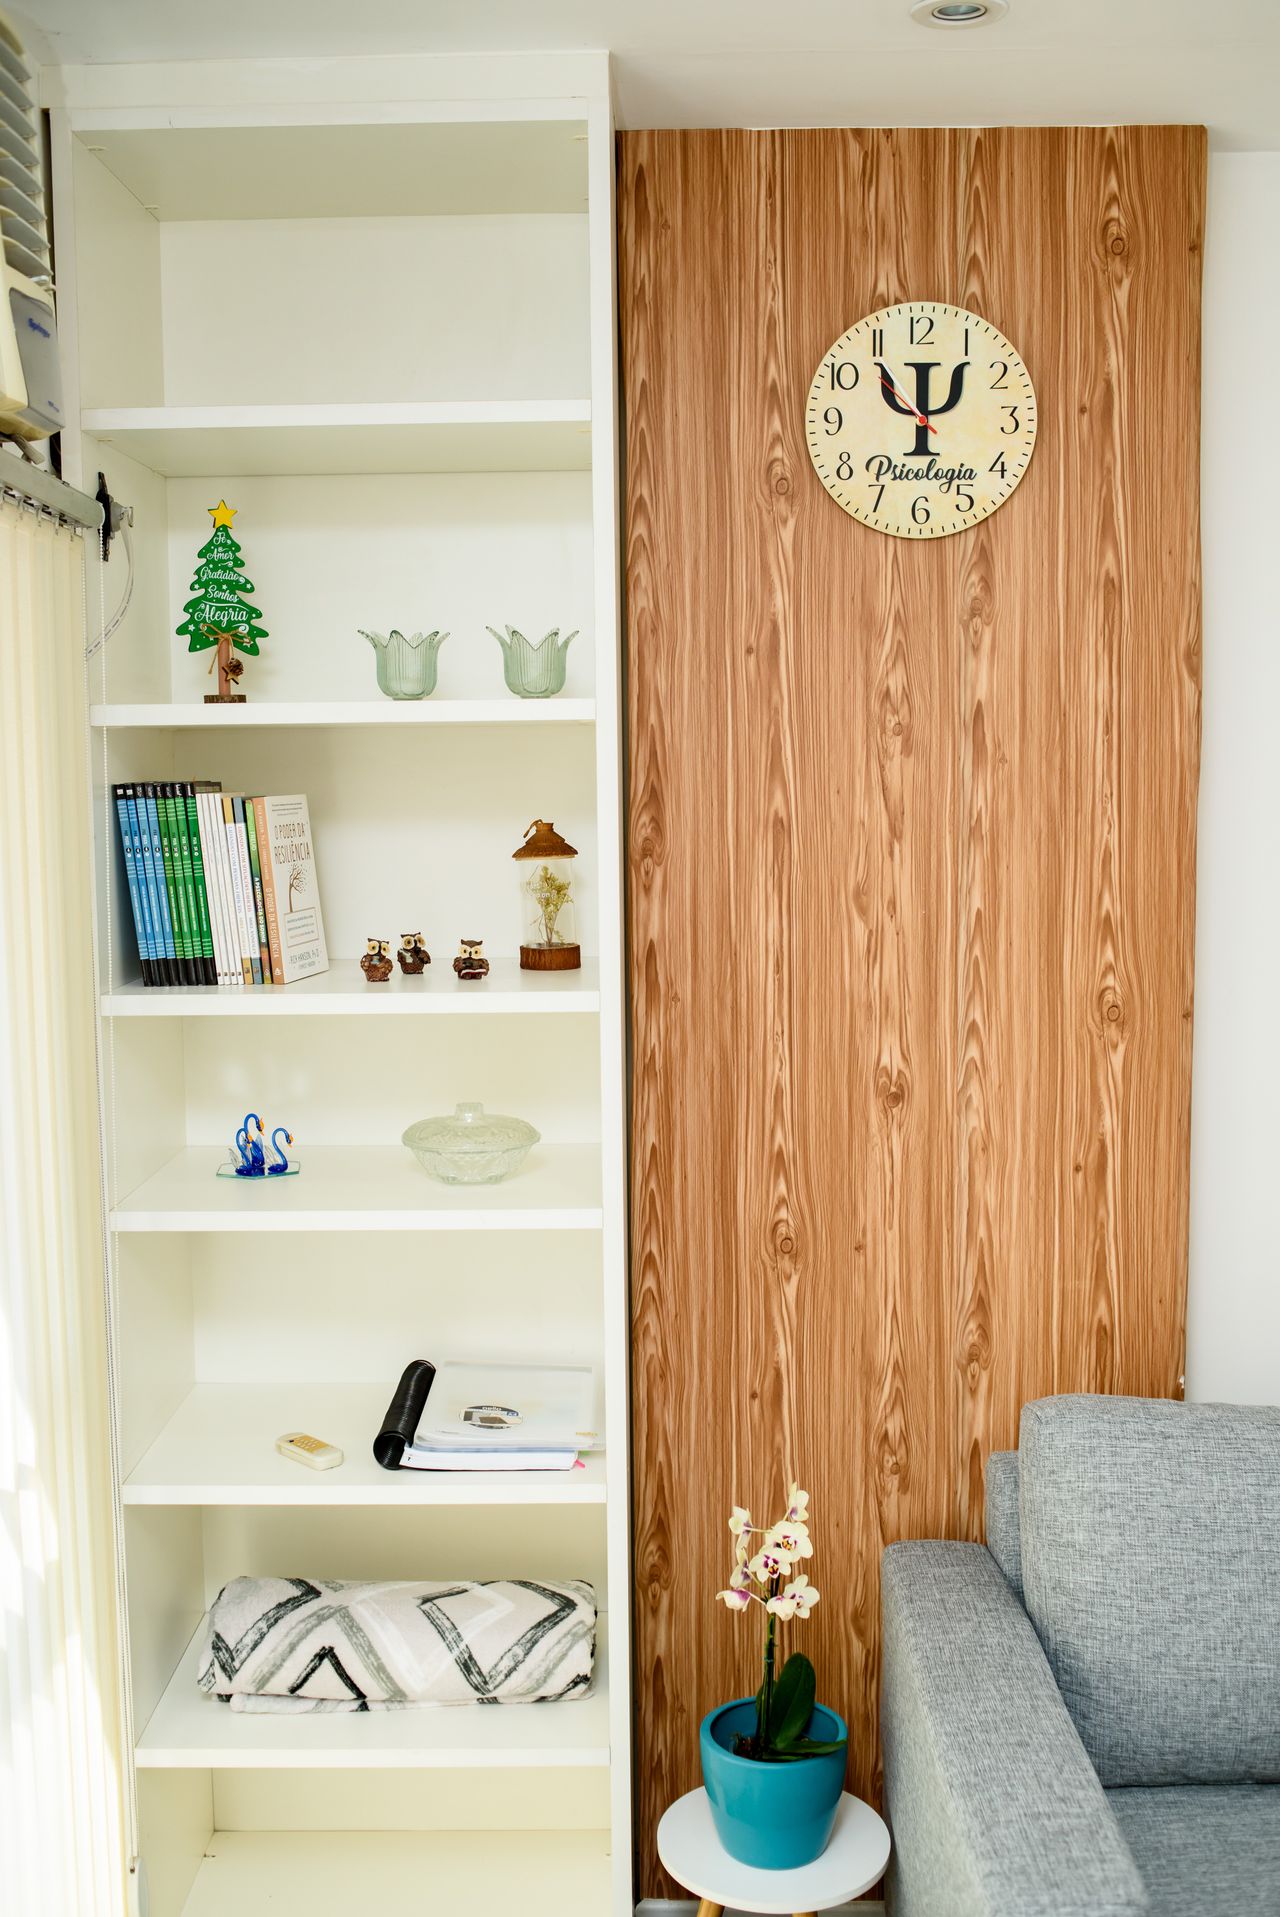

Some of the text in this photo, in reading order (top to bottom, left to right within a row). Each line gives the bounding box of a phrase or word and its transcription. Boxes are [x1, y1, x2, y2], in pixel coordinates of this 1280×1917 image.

[872, 329, 884, 358] 11
[910, 316, 935, 345] 12
[964, 328, 969, 357] 1
[830, 362, 859, 391] 10
[989, 361, 1009, 390] 2
[823, 406, 843, 436] 9
[1000, 405, 1020, 435] 3
[836, 451, 854, 481] 8
[865, 454, 977, 494] Psicologia
[988, 451, 1008, 479] 4
[868, 484, 886, 513] 7
[911, 496, 931, 525] 6
[955, 483, 975, 513] 5
[206, 548, 235, 561] Amor
[200, 566, 240, 581] Gratidão
[207, 584, 240, 603] Sonhos
[194, 603, 248, 628] Alegria
